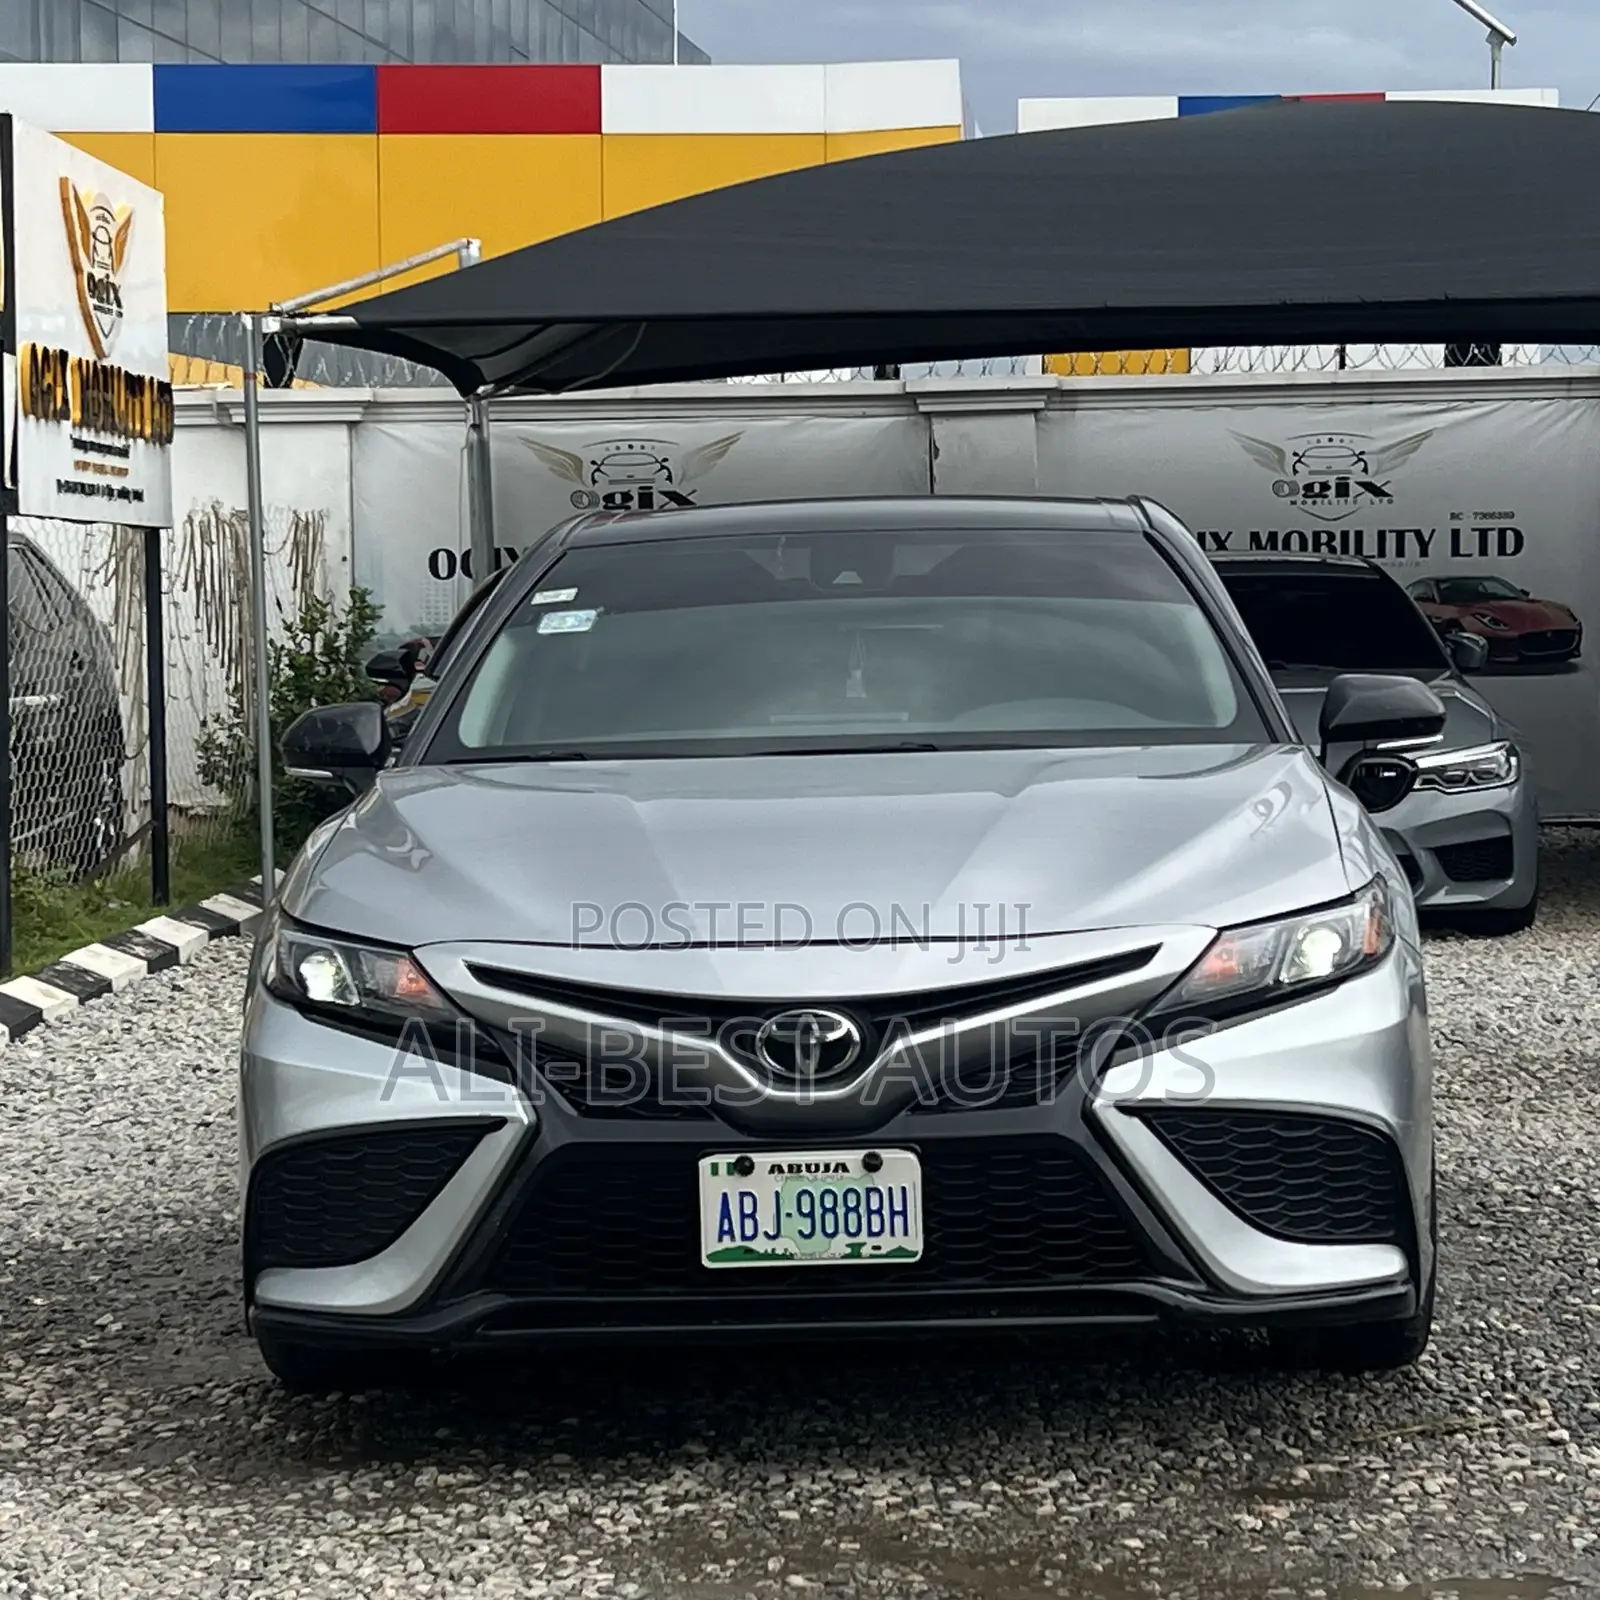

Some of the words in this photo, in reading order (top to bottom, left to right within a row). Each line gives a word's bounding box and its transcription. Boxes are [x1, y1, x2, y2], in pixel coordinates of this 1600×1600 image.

[1249, 527, 1436, 559] MOBILITY
[1450, 527, 1524, 558] LTD
[768, 1162, 850, 1175] ABUJA
[717, 1186, 909, 1243] ABJ-988BH
